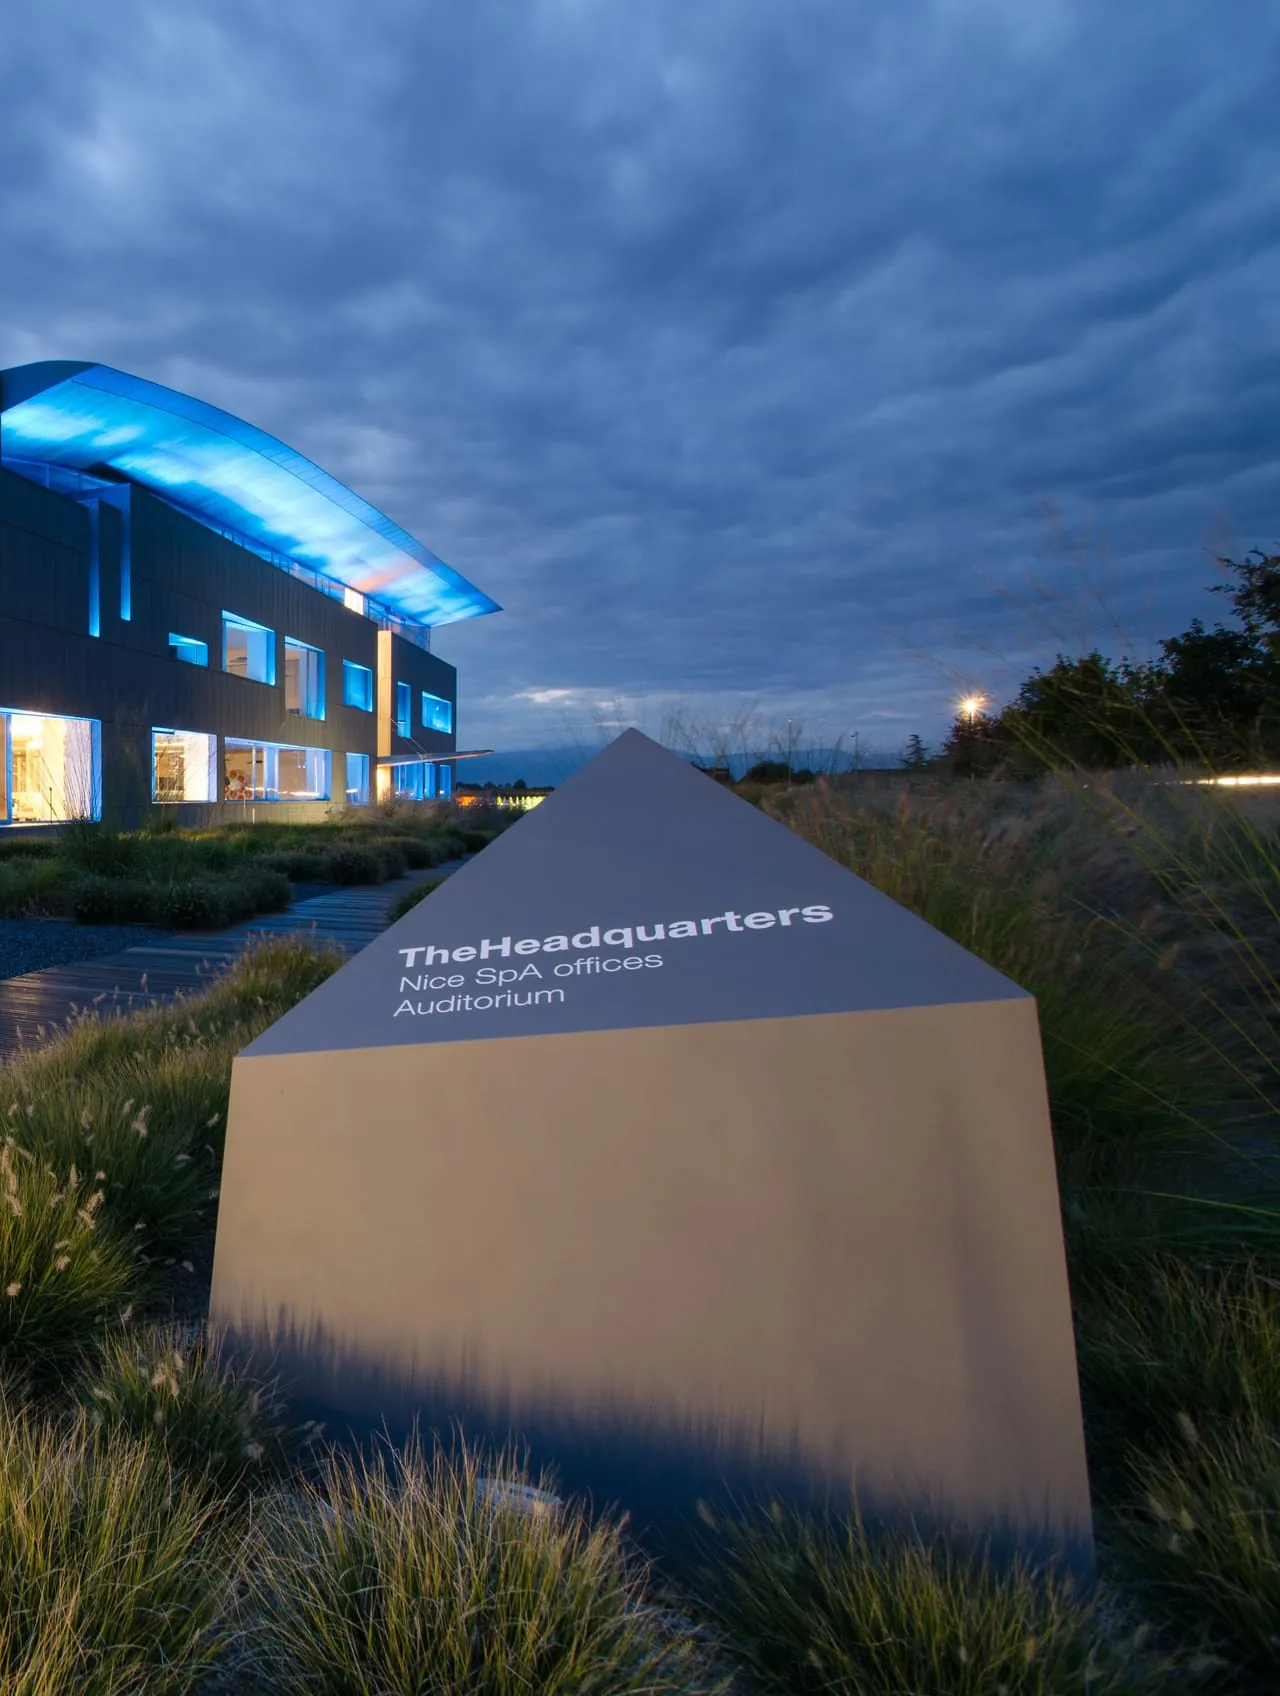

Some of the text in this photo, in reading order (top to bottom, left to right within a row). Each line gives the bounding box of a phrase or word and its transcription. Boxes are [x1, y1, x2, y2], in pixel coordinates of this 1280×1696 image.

[398, 904, 834, 968] TheHeadquarters
[399, 954, 664, 993] Nice SpA offices
[392, 987, 565, 1017] Auditorium
